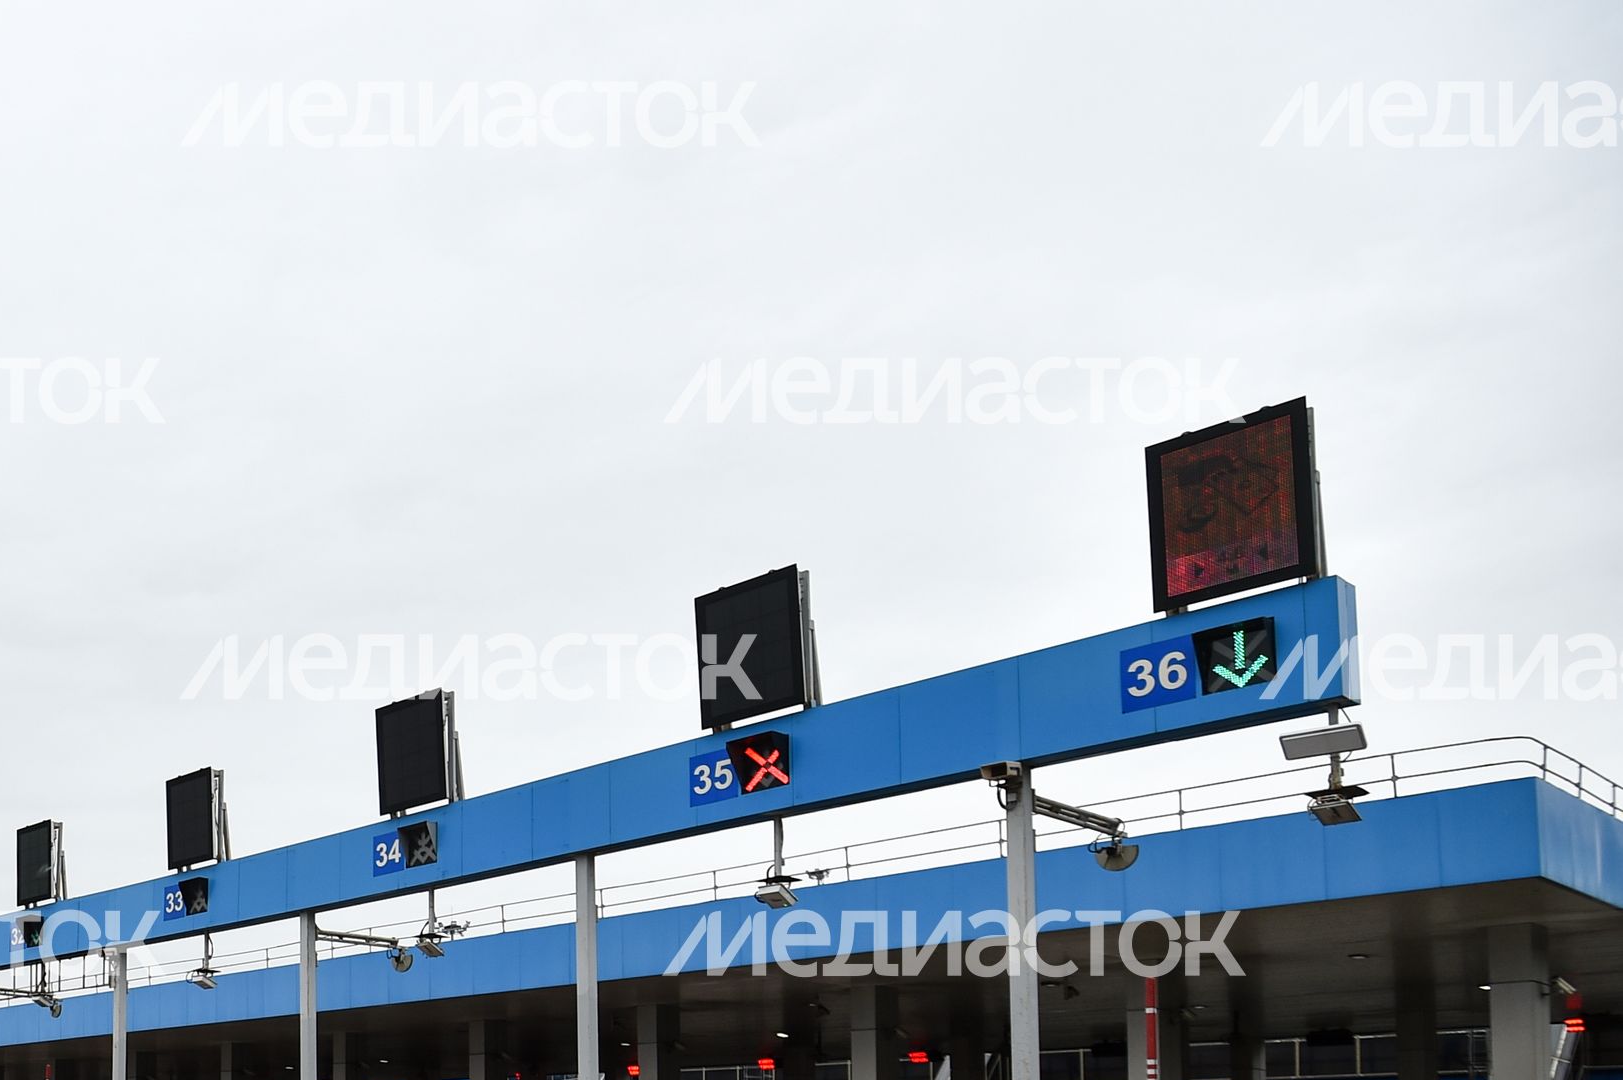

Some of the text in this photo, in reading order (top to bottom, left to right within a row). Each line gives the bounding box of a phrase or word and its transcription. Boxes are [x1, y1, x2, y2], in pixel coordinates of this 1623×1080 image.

[1127, 651, 1188, 698] 36
[693, 758, 734, 795] 35
[375, 839, 402, 868] 34
[165, 890, 184, 913] 33
